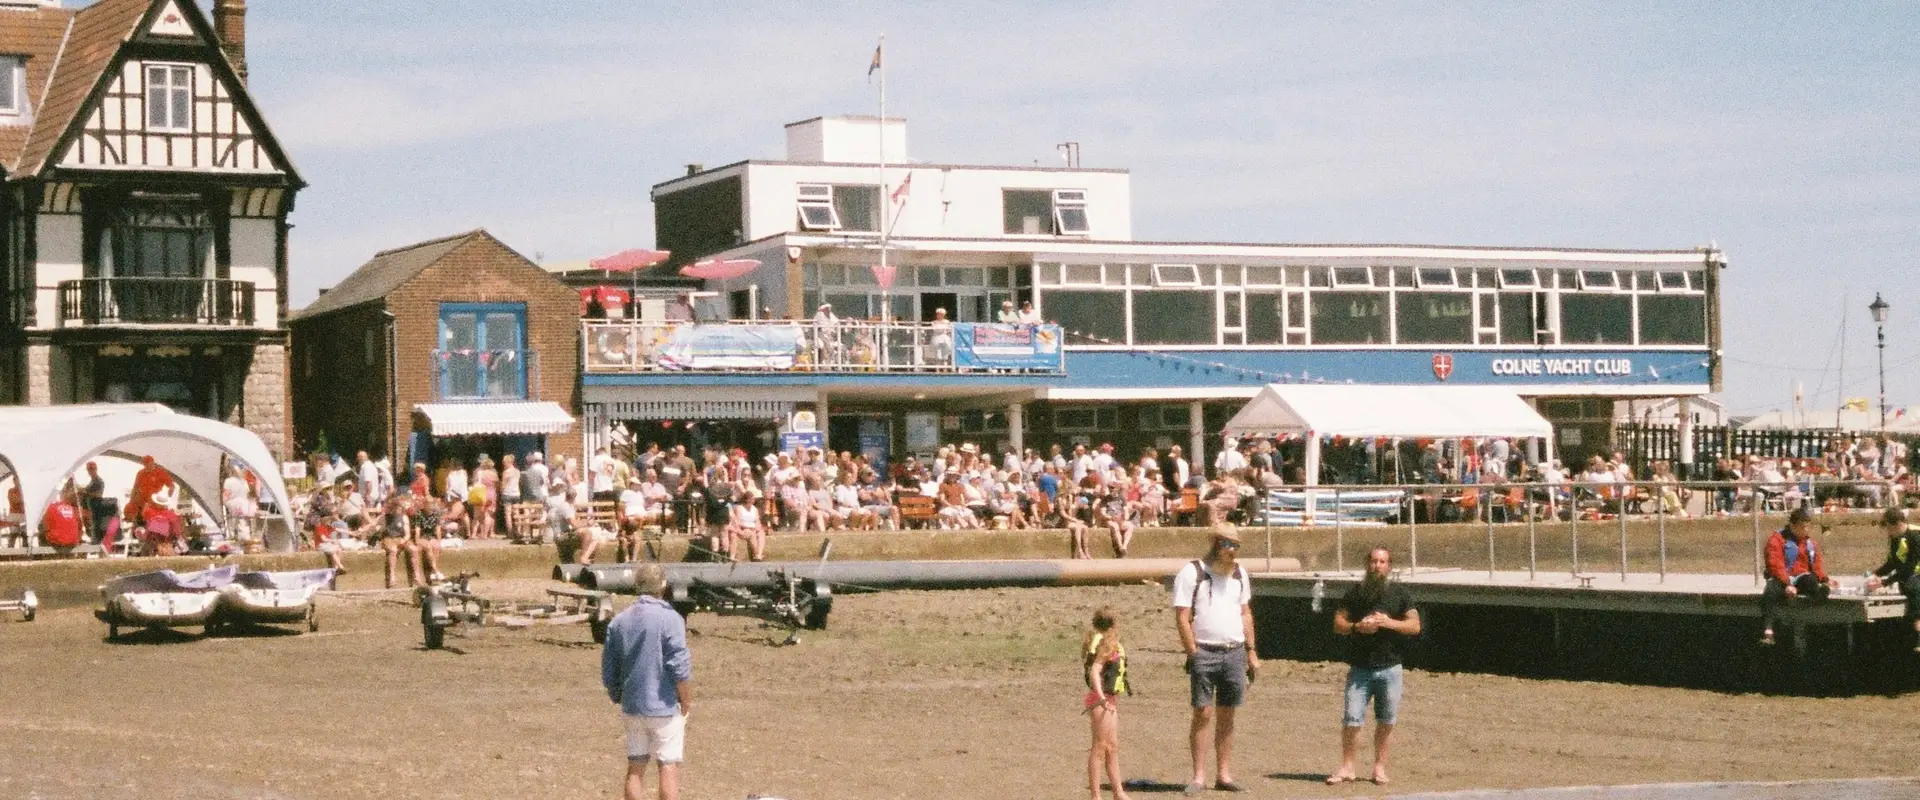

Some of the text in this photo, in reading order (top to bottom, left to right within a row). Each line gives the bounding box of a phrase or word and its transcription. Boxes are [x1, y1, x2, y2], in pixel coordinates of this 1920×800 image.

[1492, 359, 1632, 375] COLNE YACHT CLUB
